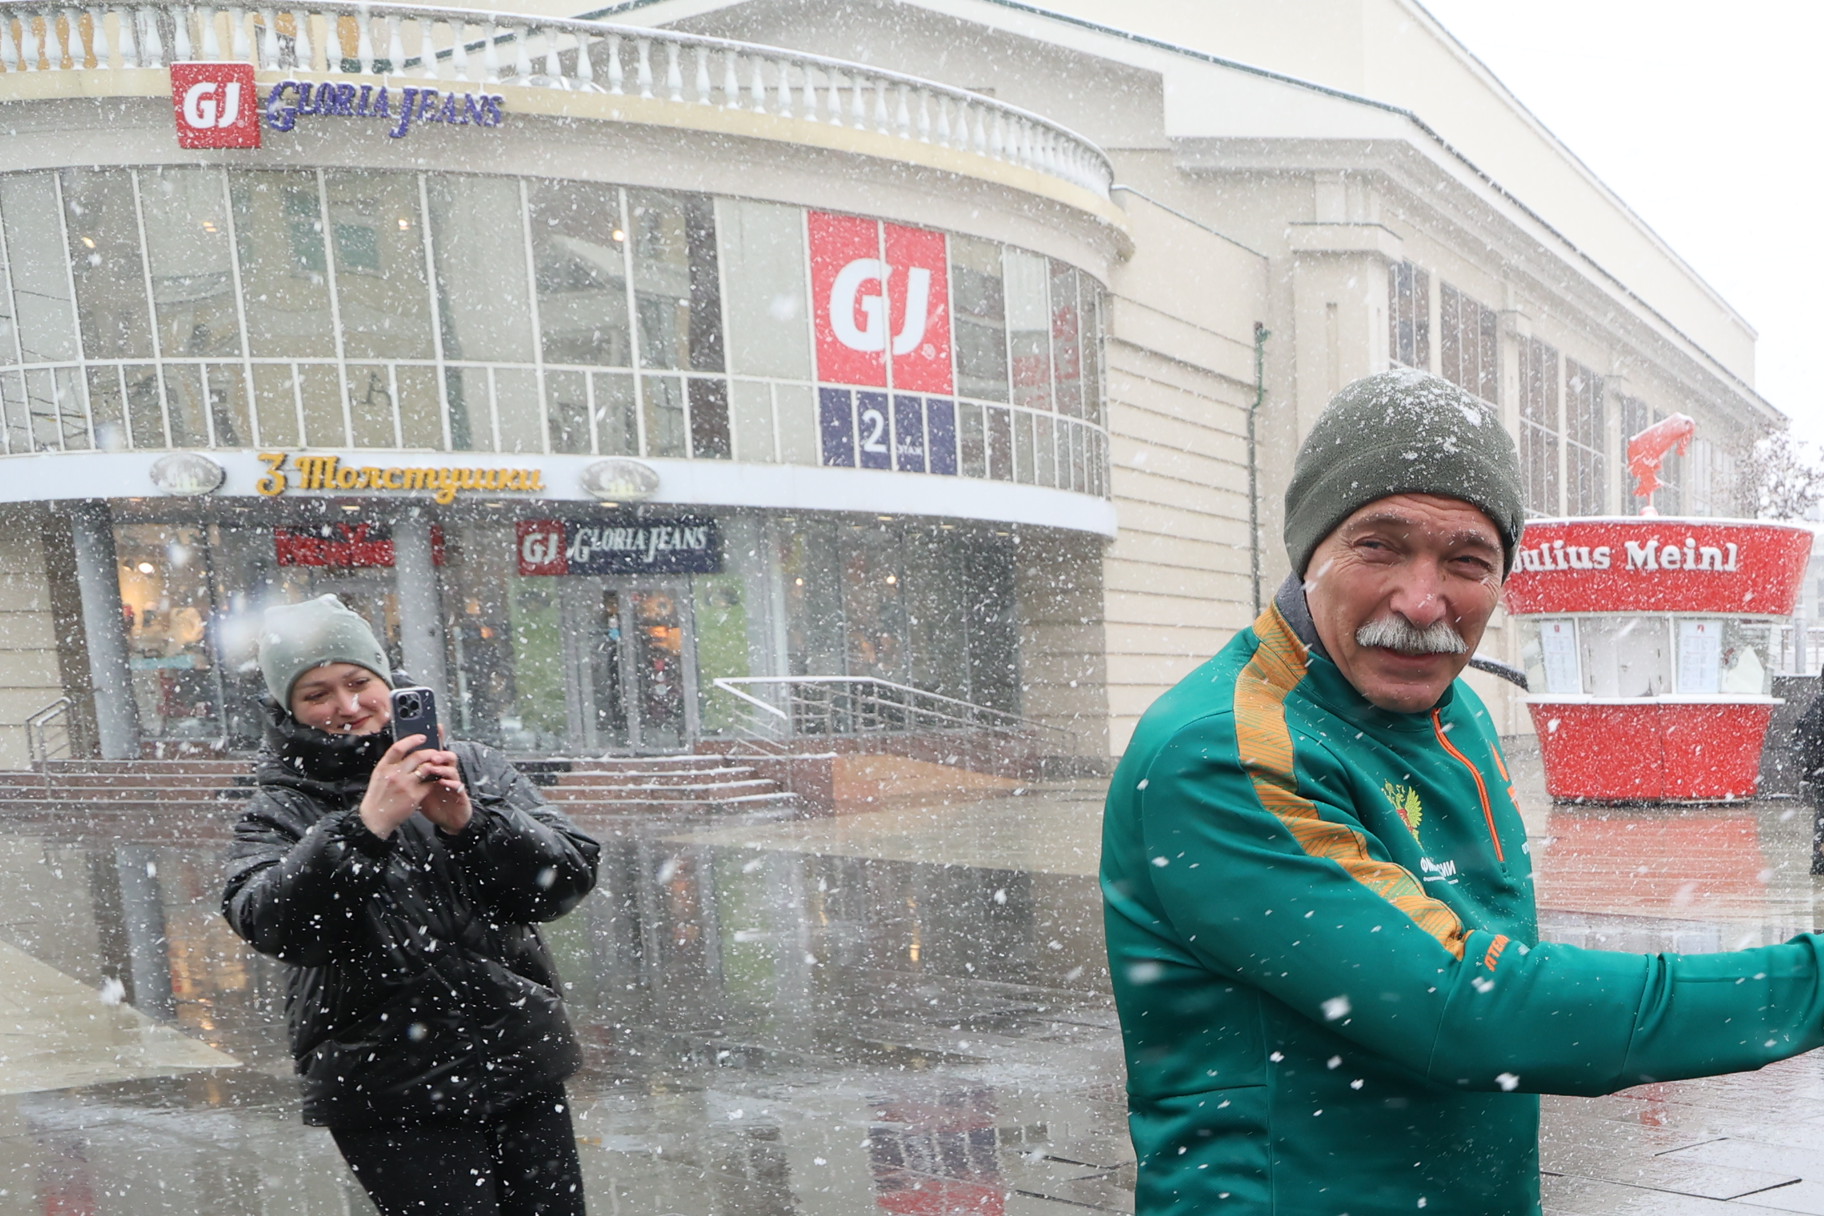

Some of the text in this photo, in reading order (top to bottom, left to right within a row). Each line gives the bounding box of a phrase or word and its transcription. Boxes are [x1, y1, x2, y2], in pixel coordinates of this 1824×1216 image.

[183, 82, 241, 128] GJ
[267, 80, 503, 137] GLORIA JEANS
[829, 257, 930, 356] GJ
[522, 532, 558, 564] GJ
[643, 526, 708, 563] JEANS
[1624, 537, 1739, 572] Meinl
